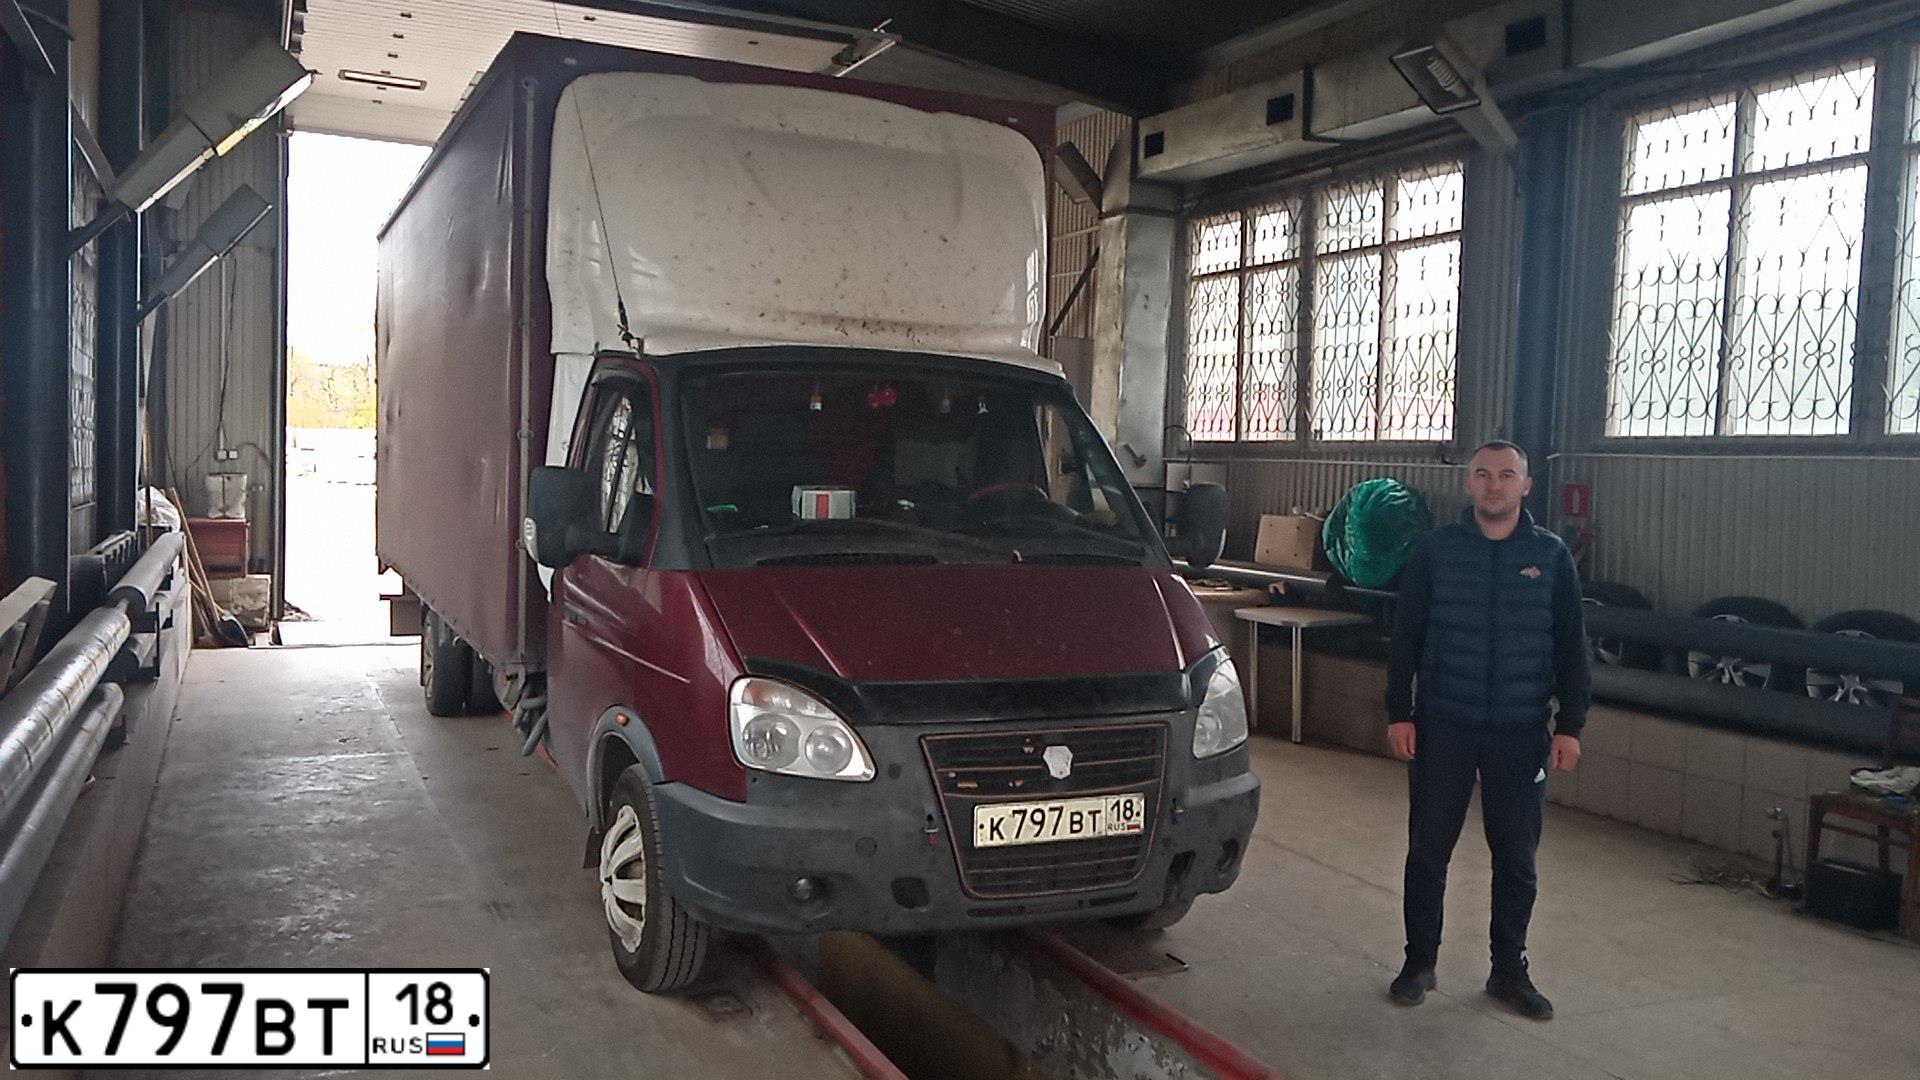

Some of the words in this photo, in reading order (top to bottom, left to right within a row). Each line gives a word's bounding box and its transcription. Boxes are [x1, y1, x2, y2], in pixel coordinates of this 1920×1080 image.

[1110, 799, 1134, 822] 18
[989, 806, 1102, 841] К797ВТ
[1107, 823, 1126, 832] RUS
